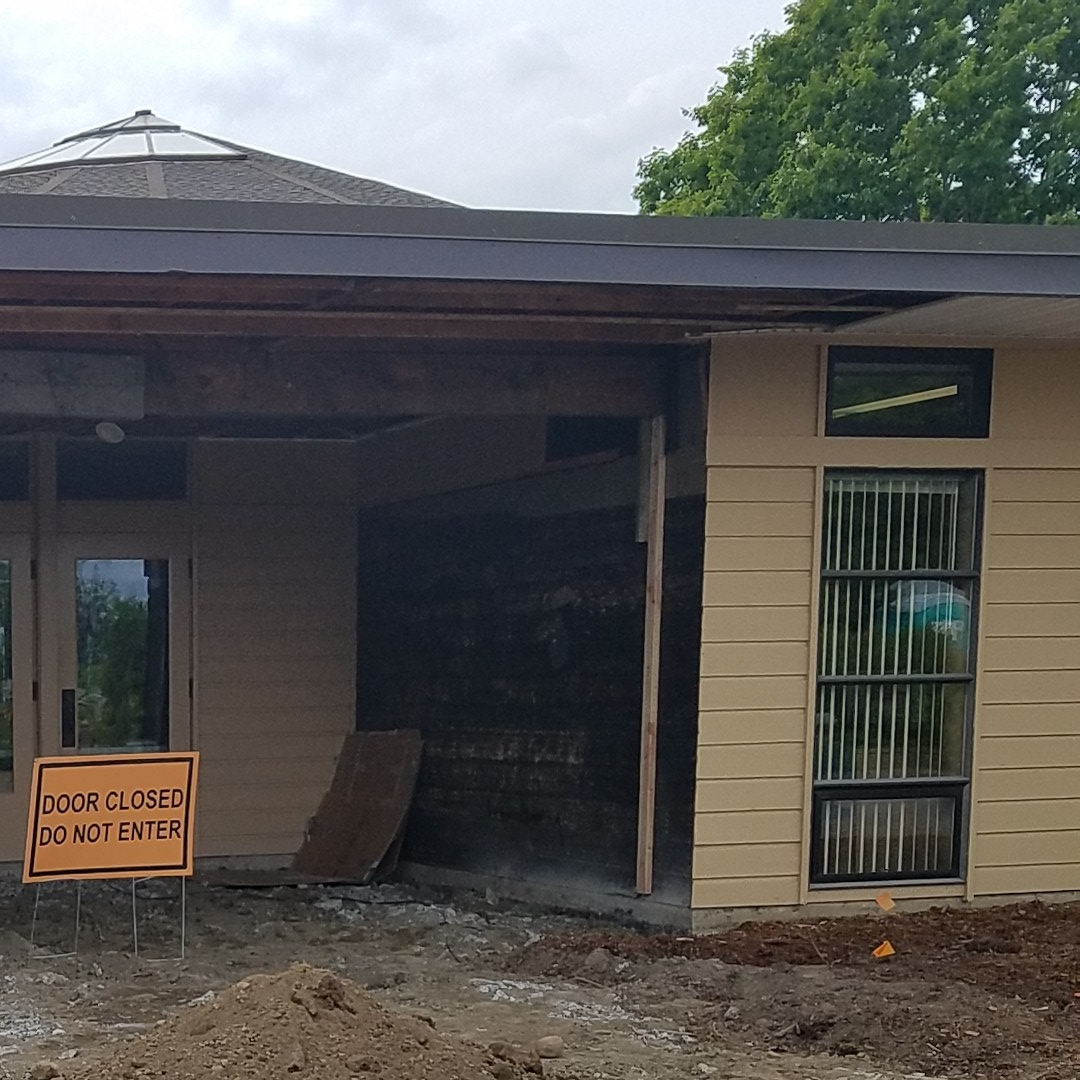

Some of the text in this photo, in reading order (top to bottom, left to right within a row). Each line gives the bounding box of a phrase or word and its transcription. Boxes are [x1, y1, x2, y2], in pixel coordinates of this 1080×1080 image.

[42, 788, 184, 815] DOOR CLOSED
[39, 820, 182, 846] DO NOT ENTER
